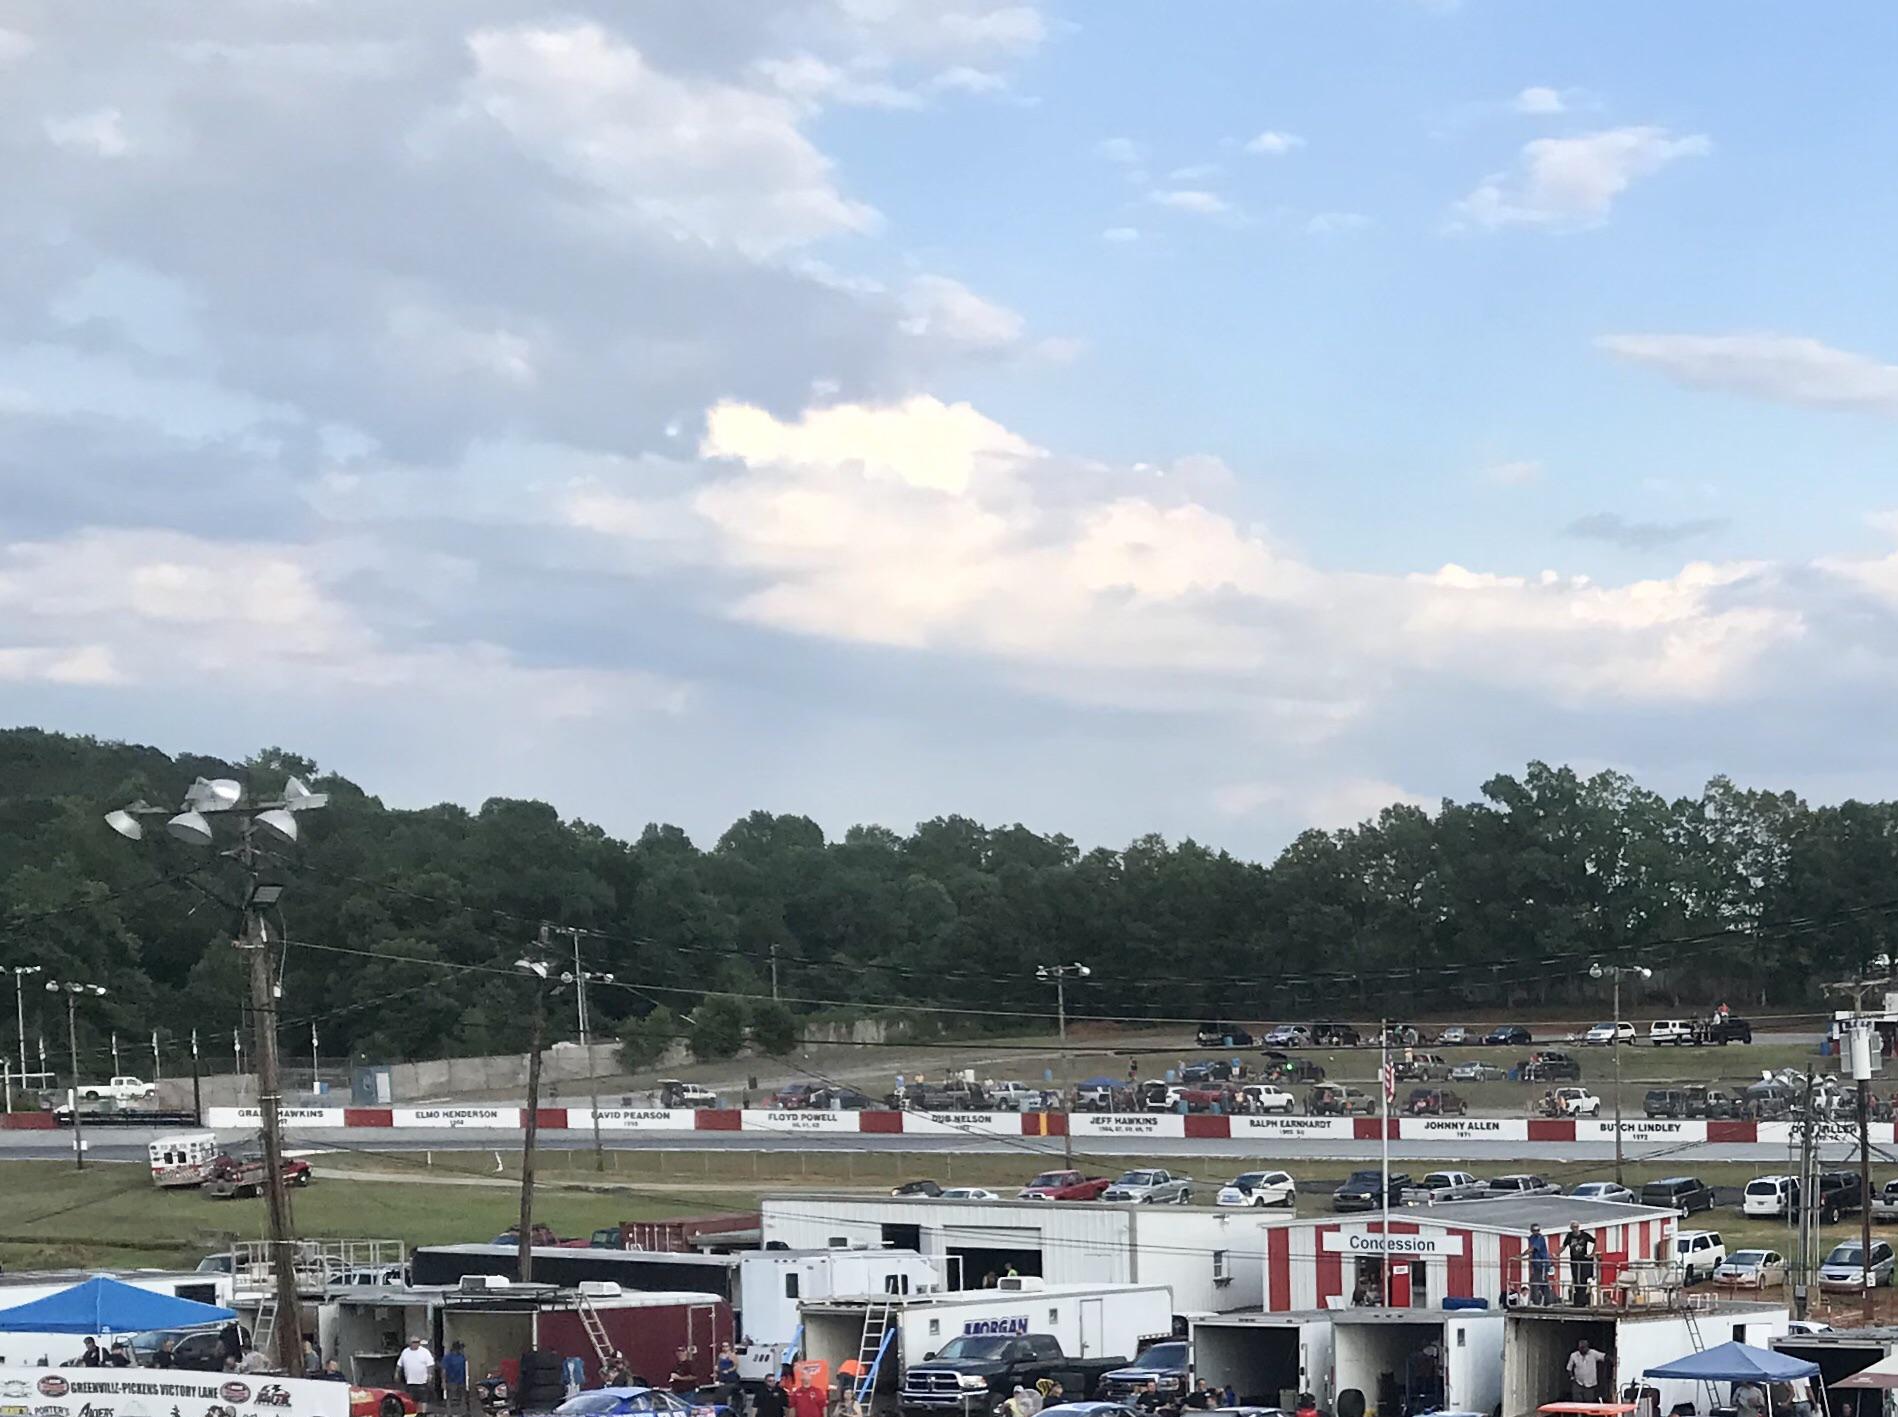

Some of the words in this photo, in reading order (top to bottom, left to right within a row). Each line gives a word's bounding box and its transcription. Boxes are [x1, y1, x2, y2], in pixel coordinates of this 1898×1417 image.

[415, 1110, 440, 1119] ELMO
[442, 1110, 497, 1119] HENDERSON
[623, 1111, 671, 1120] PEARSON
[768, 1113, 798, 1121] FLOYD
[800, 1113, 838, 1122] POWELL
[954, 1115, 992, 1123] NELSON
[1090, 1116, 1112, 1125] JEFF
[1114, 1117, 1158, 1126] HAWKINS
[1249, 1119, 1278, 1128] RALPH
[1280, 1120, 1332, 1128] EARNHARDT
[1424, 1121, 1465, 1130] JOHNNY
[1467, 1121, 1499, 1130] ALLEN
[1600, 1123, 1635, 1131] BUCH
[1638, 1124, 1681, 1132] LINDLEY
[1350, 1235, 1435, 1252] Concession
[71, 1381, 158, 1396] GREENVILLE-PICKENS
[160, 1383, 196, 1398] VICTORY
[198, 1386, 218, 1399] LANE
